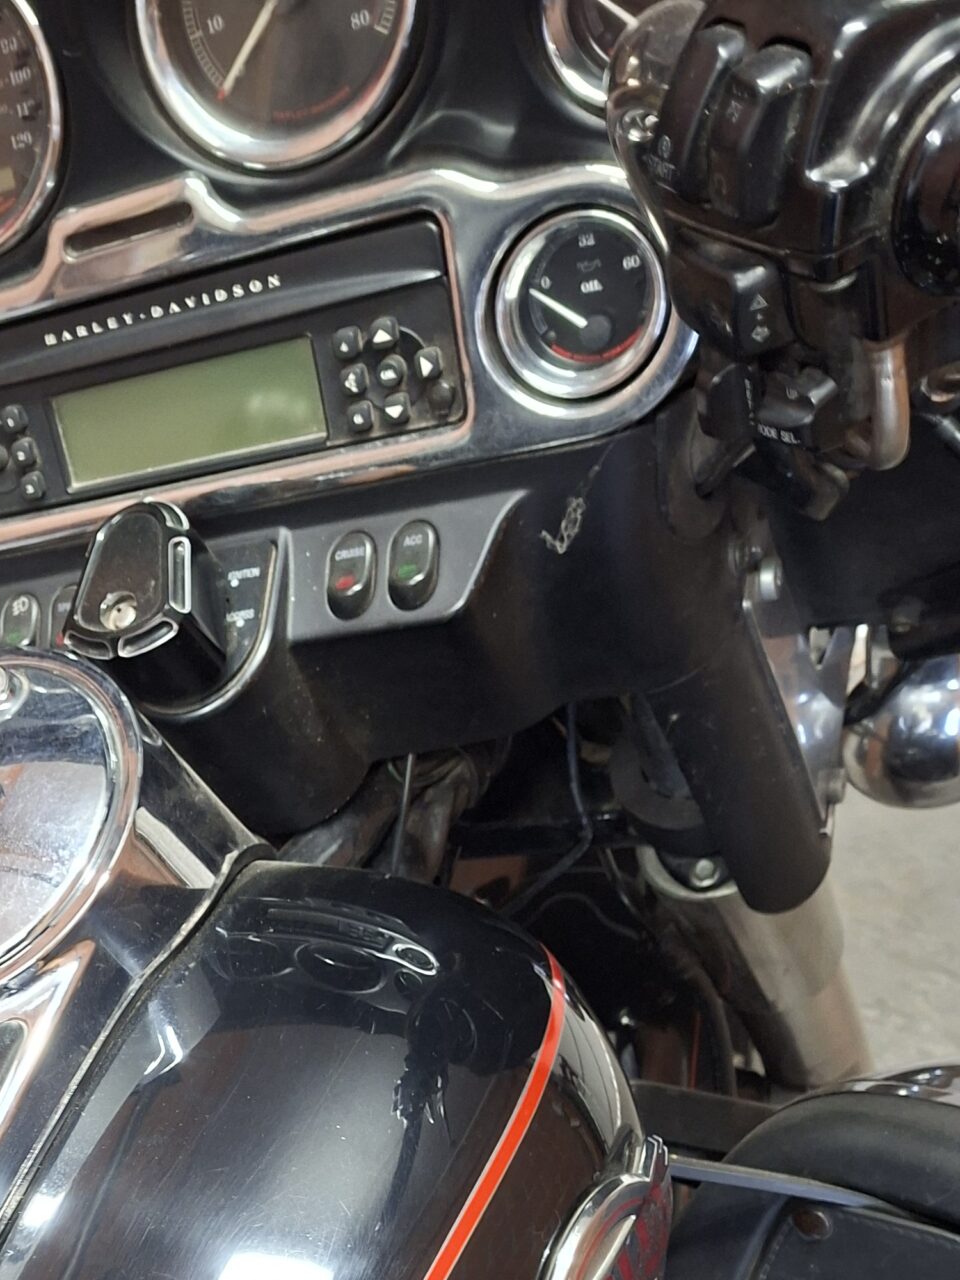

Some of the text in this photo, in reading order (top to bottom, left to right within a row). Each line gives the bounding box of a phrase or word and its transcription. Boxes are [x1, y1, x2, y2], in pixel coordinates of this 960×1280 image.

[206, 14, 224, 35] 10
[350, 9, 371, 31] 80
[9, 66, 32, 86] 100
[622, 254, 641, 271] 60
[541, 275, 551, 290] 0
[403, 533, 423, 547] ACC
